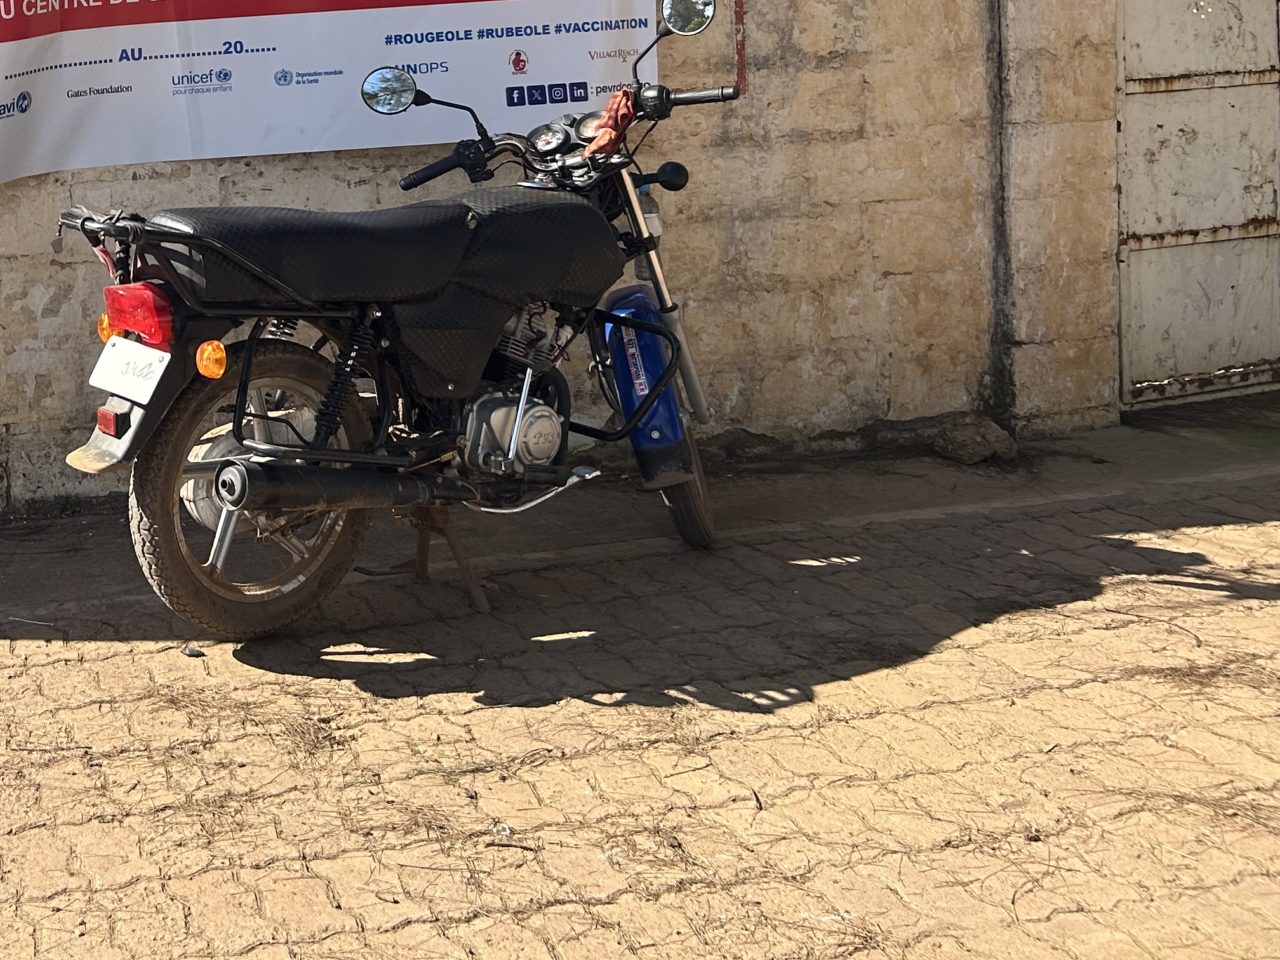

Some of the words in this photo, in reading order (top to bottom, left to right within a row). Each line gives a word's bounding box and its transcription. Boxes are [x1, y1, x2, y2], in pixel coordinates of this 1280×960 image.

[384, 29, 473, 46] #ROUGEOLE
[477, 24, 551, 40] #RUBEOLE
[554, 17, 649, 35] #VACCINATION
[171, 68, 214, 86] unicef
[66, 89, 88, 99] Gates
[89, 84, 133, 96] Foundation
